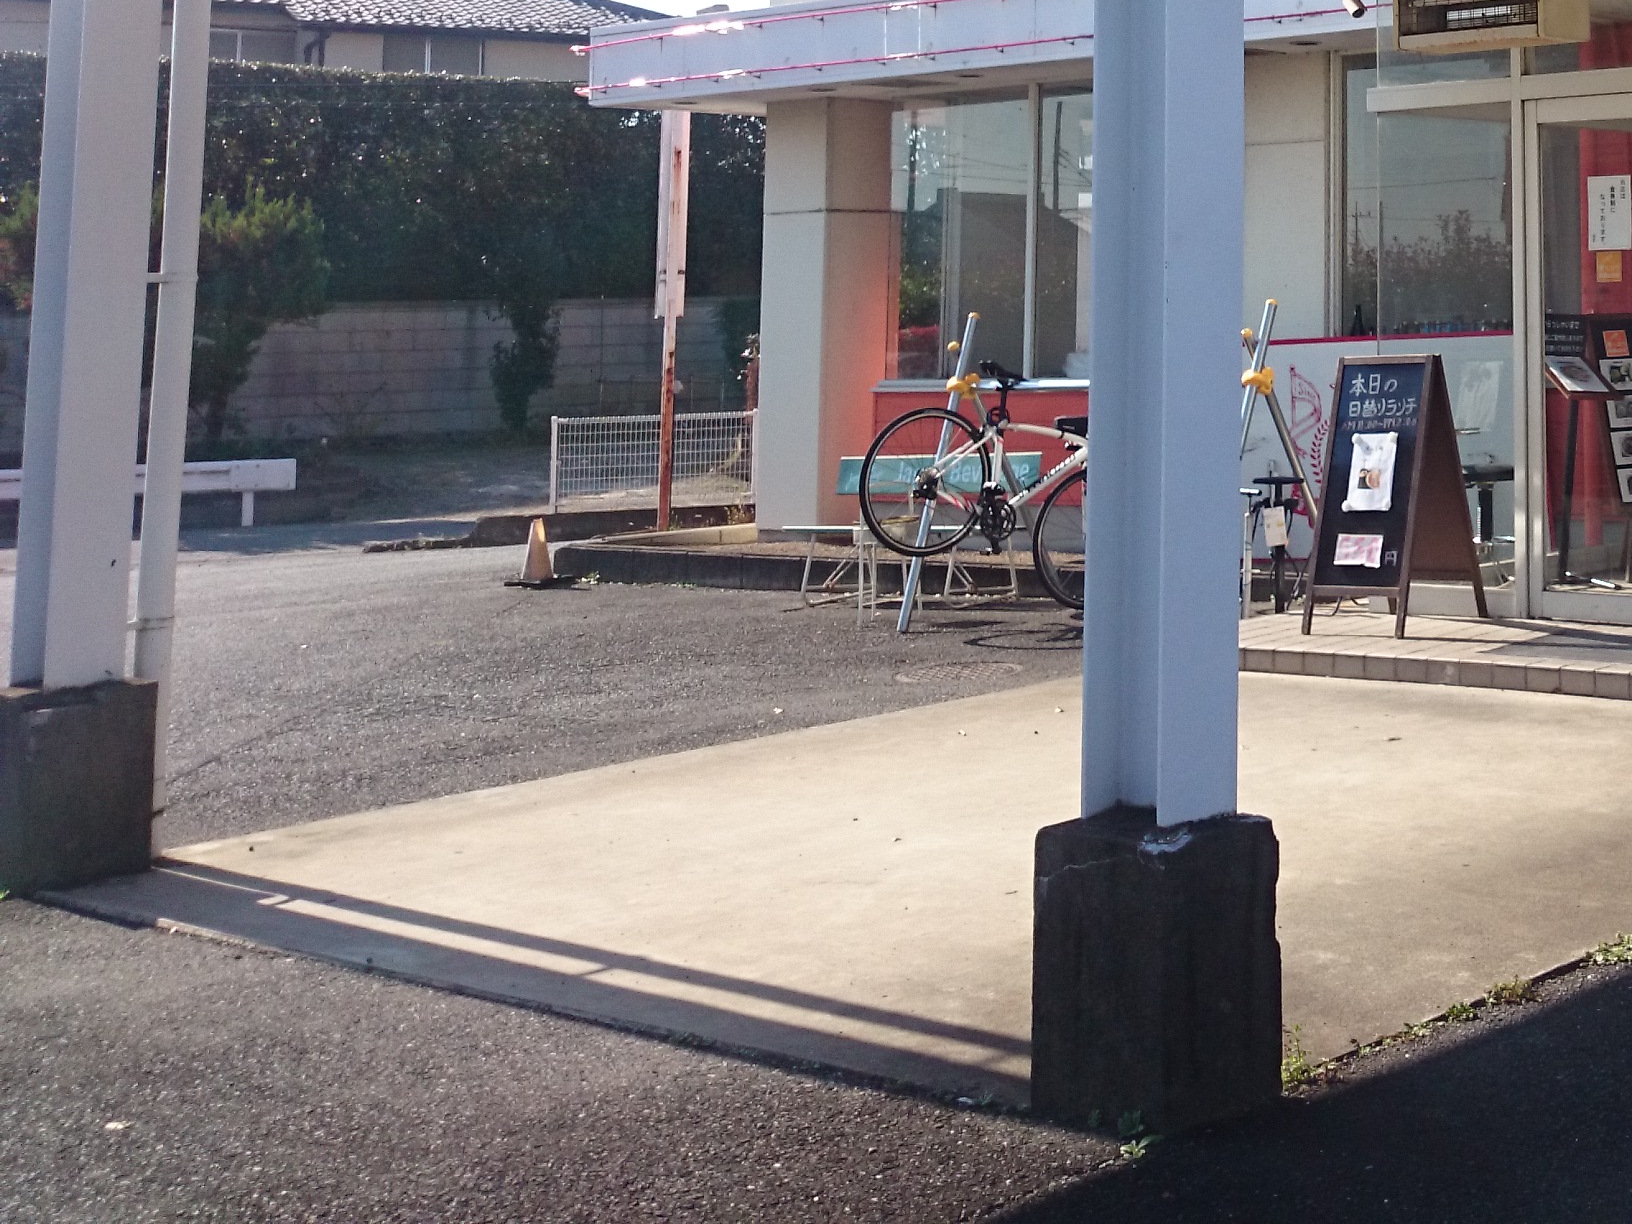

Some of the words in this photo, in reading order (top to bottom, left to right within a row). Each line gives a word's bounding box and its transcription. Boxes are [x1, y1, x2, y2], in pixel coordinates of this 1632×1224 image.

[1349, 373, 1398, 397] 本日の
[1348, 397, 1417, 417] 日替りランチ
[1384, 550, 1398, 566] 円
